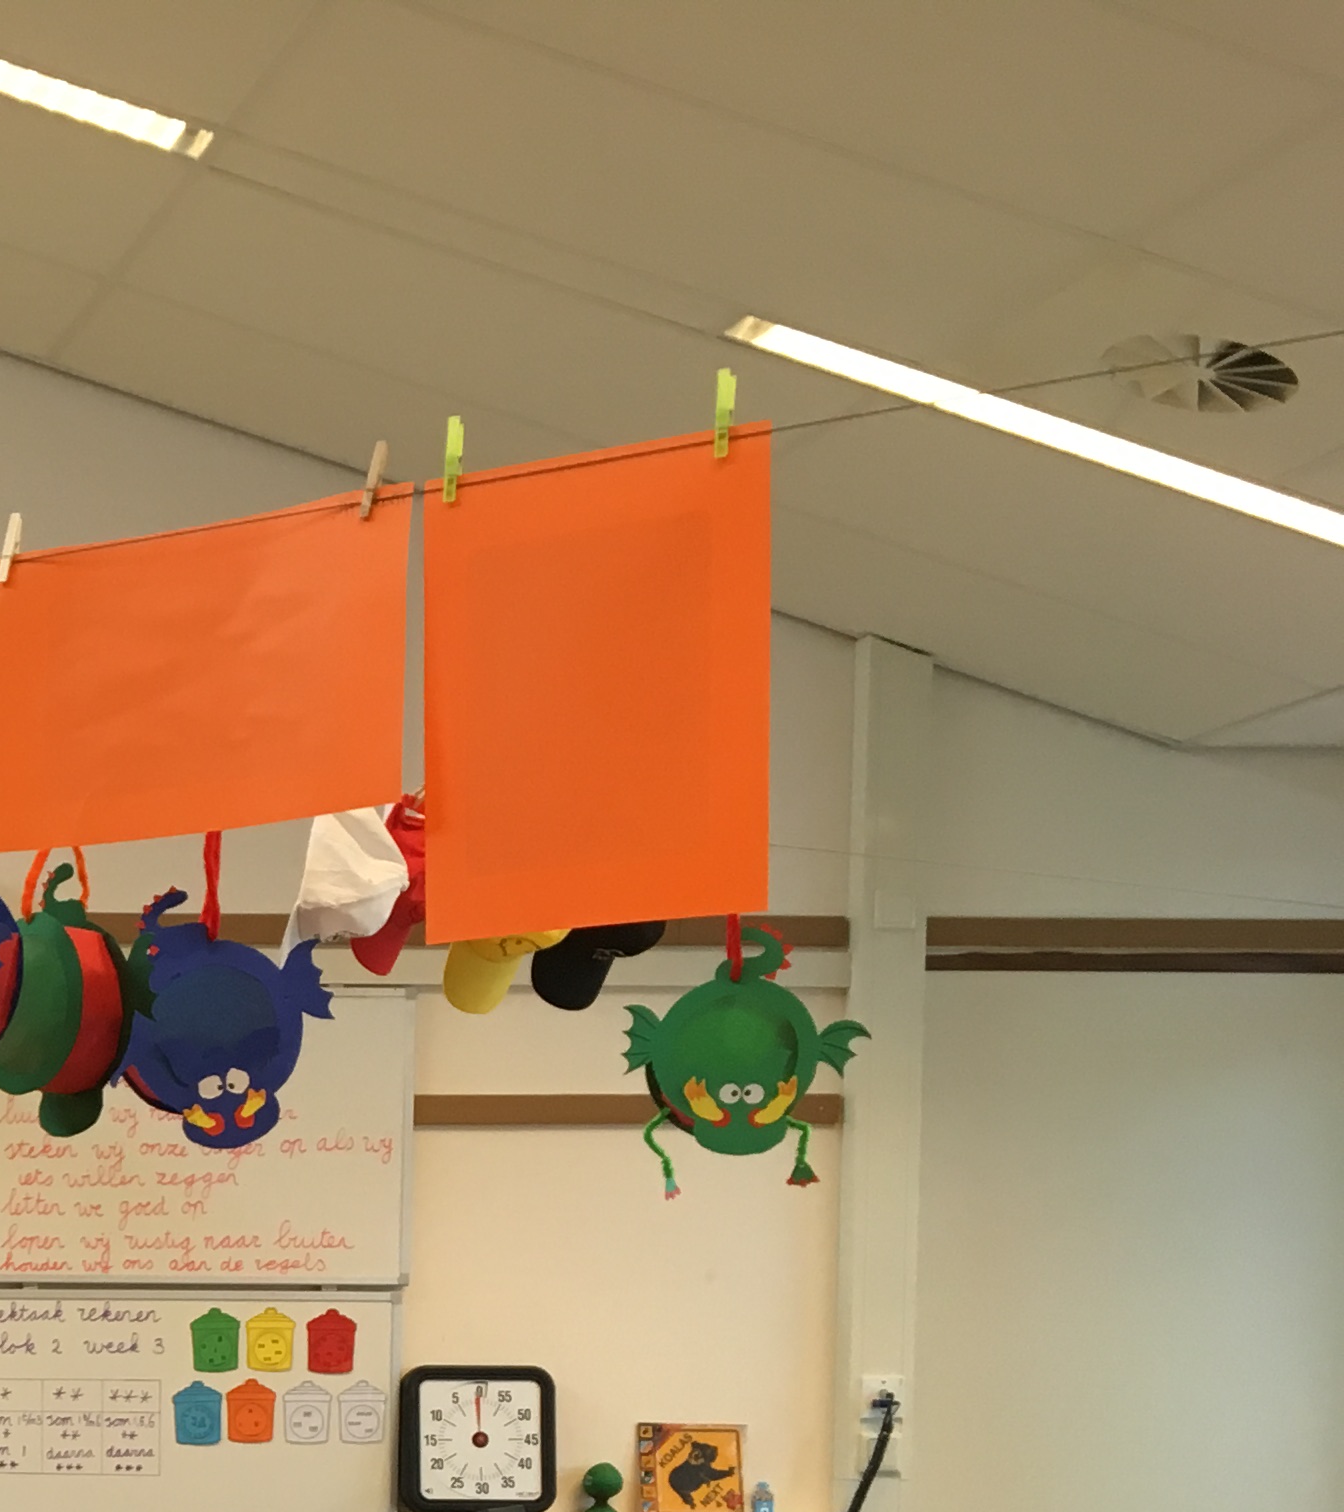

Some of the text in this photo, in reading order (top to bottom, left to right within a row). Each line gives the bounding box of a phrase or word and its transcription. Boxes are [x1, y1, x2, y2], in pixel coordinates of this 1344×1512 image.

[4, 1133, 78, 1160] steken
[138, 1141, 189, 1159] onze
[279, 1136, 308, 1159] op
[315, 1126, 355, 1152] als
[18, 1163, 239, 1199] iets willen zeggen
[0, 1187, 67, 1217] letten
[117, 1195, 170, 1231] goed
[181, 1199, 208, 1221] op
[0, 1222, 66, 1255] lopen
[123, 1230, 197, 1262] rustig
[203, 1233, 263, 1251] naar
[122, 1257, 155, 1271] ons
[169, 1257, 212, 1272] aan
[220, 1256, 244, 1272] de
[254, 1252, 327, 1276] regels
[76, 1300, 162, 1323] rekenen
[51, 1338, 63, 1355] 2
[83, 1331, 140, 1355] week
[152, 1337, 165, 1355] 3
[451, 1391, 460, 1404] 5
[497, 1390, 513, 1403] 55
[430, 1409, 443, 1422] 10
[517, 1408, 532, 1421] 50
[424, 1434, 438, 1447] 15
[523, 1433, 539, 1446] 45
[658, 1432, 694, 1469] KOALAS
[430, 1457, 444, 1470] 20
[518, 1457, 533, 1470] 40
[450, 1476, 465, 1489] 25
[474, 1482, 490, 1495] 30
[501, 1475, 516, 1489] 35
[699, 1482, 725, 1508] NEXT
